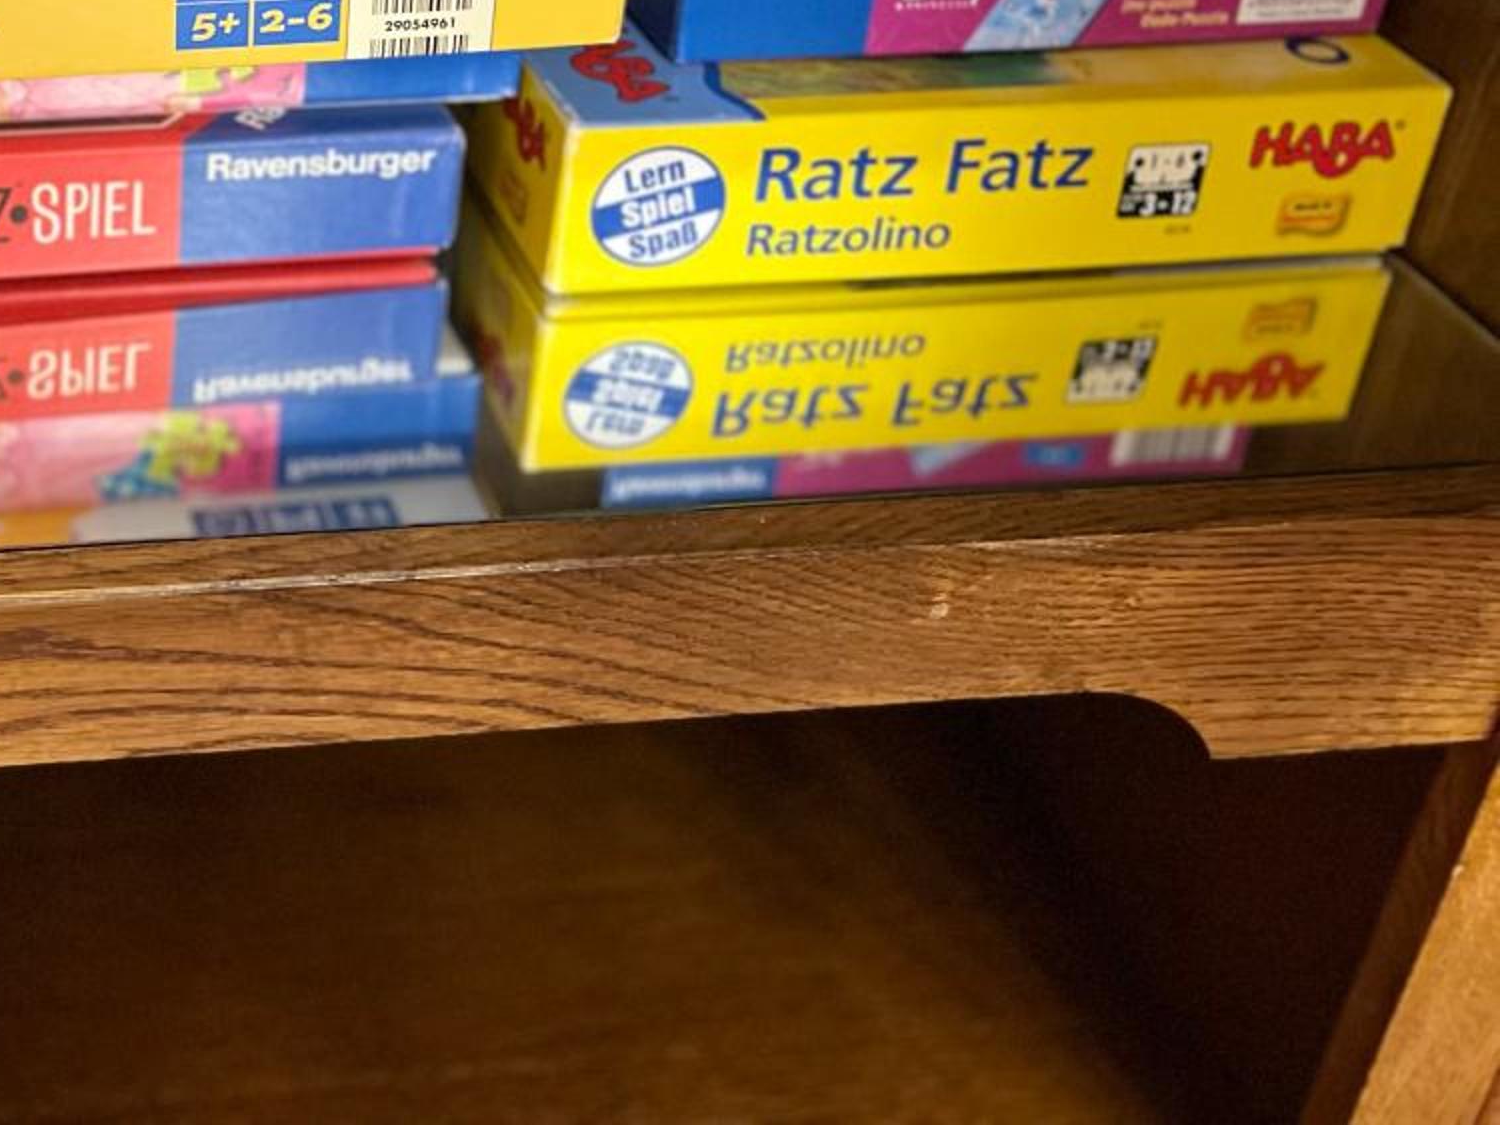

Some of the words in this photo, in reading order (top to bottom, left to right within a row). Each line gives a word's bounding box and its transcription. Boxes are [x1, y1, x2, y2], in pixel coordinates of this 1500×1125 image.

[190, 11, 241, 42] 5+
[384, 16, 457, 33] 29054961
[206, 147, 437, 181] Ravensburger
[1249, 119, 1395, 178] HABA
[623, 159, 686, 193] Lern
[754, 146, 918, 202] Ratz
[944, 138, 1095, 194] Fatz
[620, 184, 695, 229] Spiel
[629, 220, 698, 259] Spaß
[746, 216, 952, 257] Ratzolino
